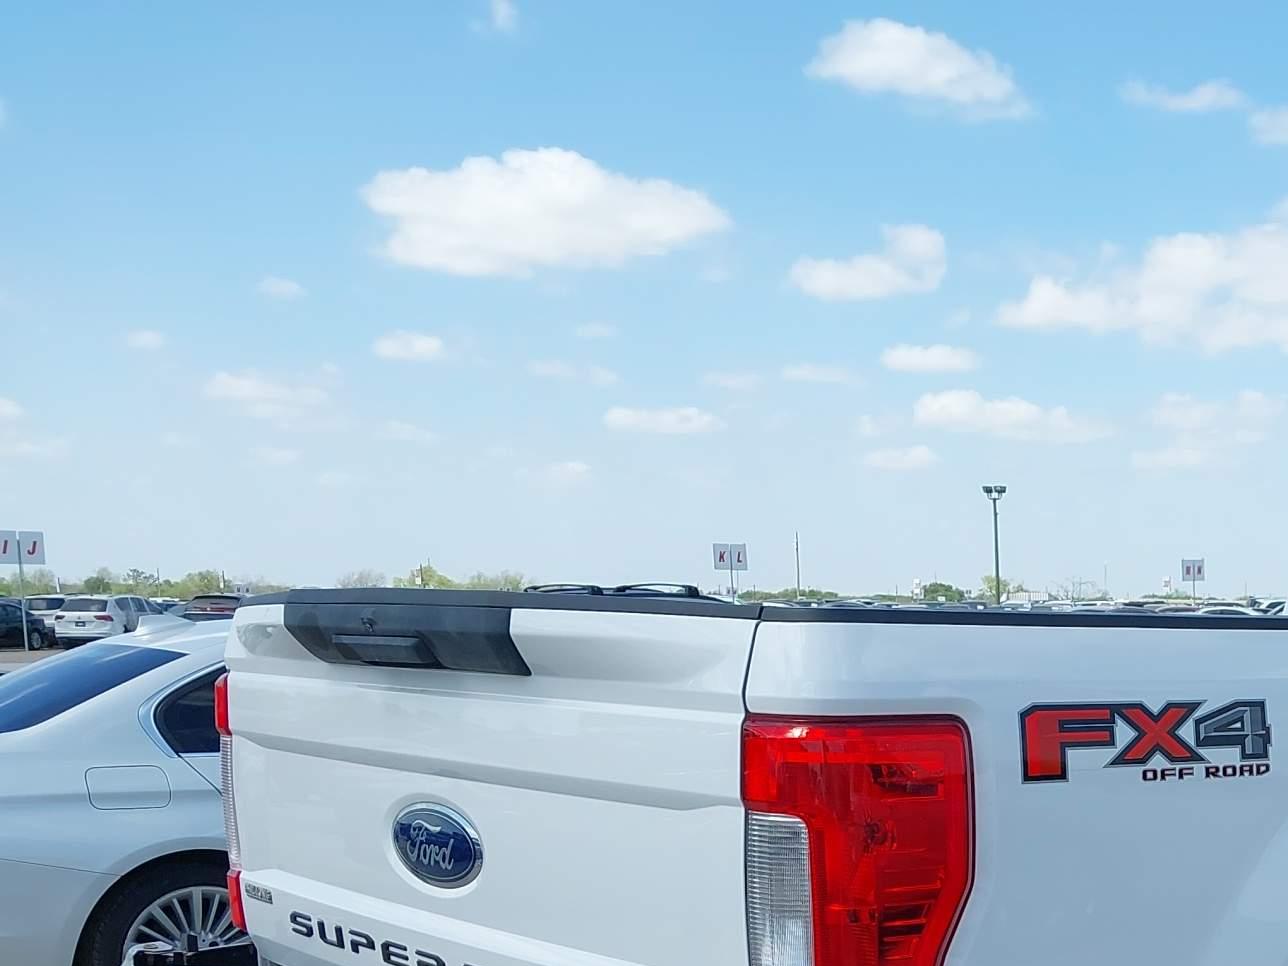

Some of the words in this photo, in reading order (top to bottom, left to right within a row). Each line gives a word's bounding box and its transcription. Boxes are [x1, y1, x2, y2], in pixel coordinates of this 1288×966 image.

[2, 539, 9, 555] I
[27, 540, 37, 556] J
[718, 550, 727, 563] K
[736, 551, 743, 563] L
[1018, 699, 1272, 784] FX4
[1142, 767, 1195, 782] OFF
[1204, 763, 1270, 780] ROAD
[406, 819, 455, 870] Ford
